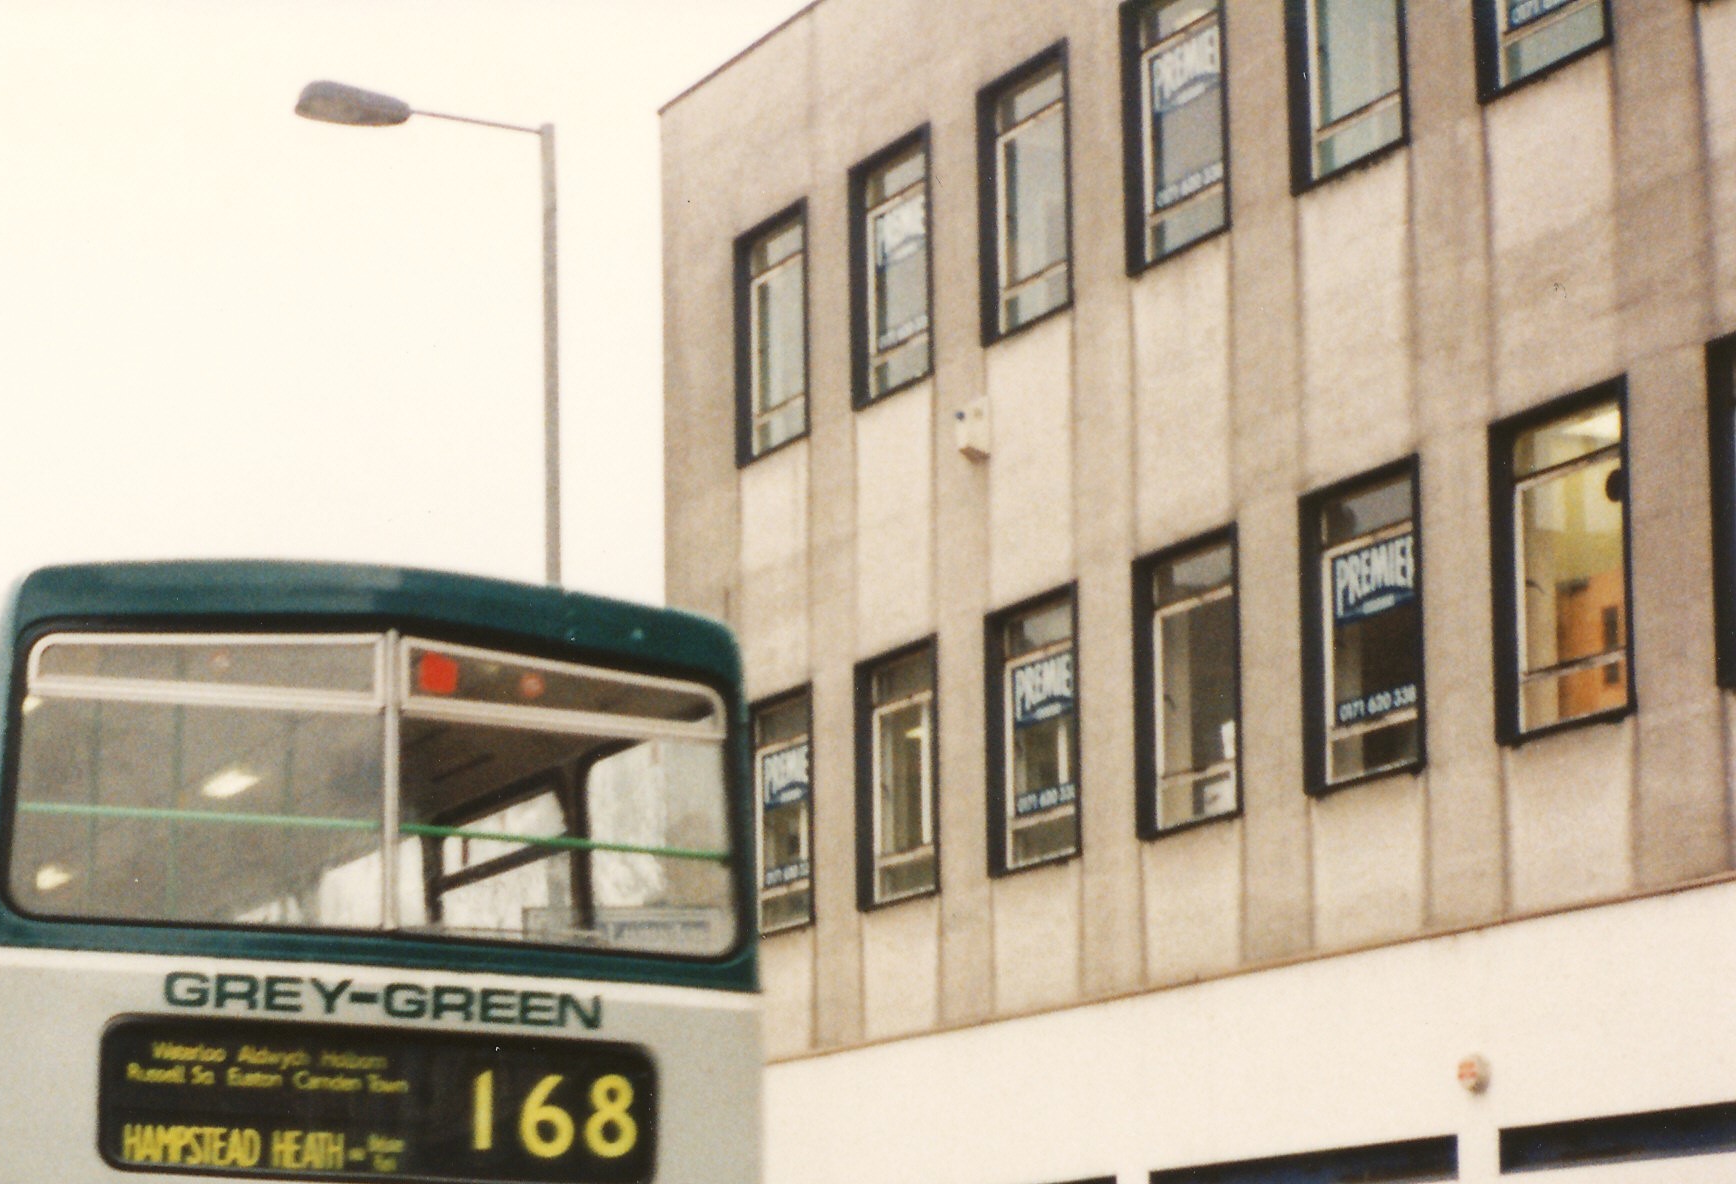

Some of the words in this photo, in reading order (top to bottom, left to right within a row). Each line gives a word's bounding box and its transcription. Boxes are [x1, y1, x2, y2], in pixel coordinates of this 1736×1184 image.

[164, 970, 602, 1030] GREY-GREEN
[472, 1070, 638, 1159] 168
[123, 1123, 262, 1167] HAMPSTEAD
[271, 1130, 345, 1170] HEATH
